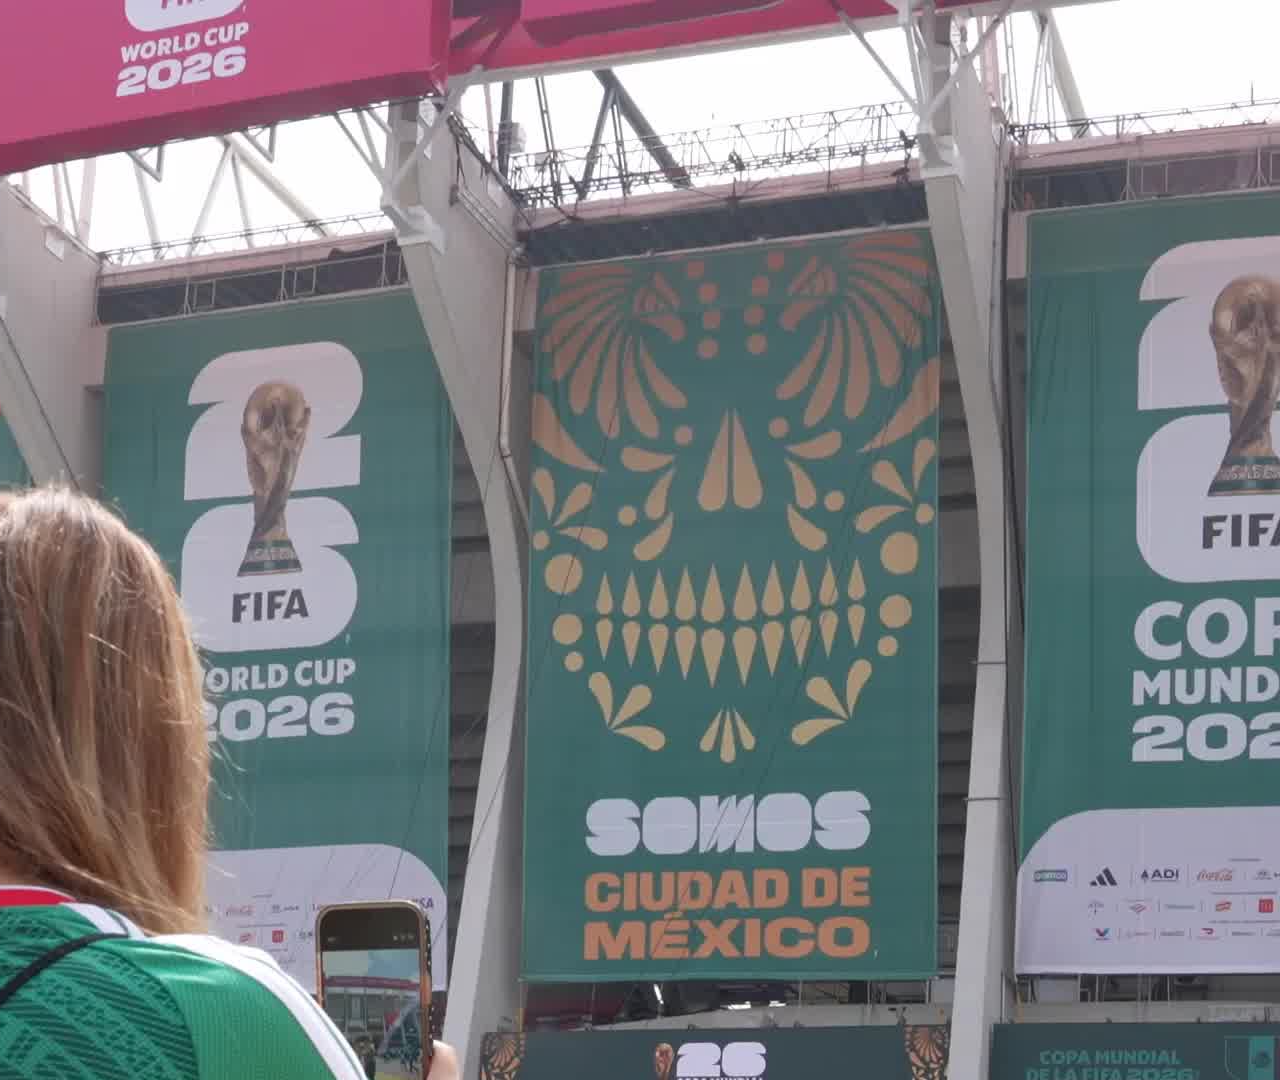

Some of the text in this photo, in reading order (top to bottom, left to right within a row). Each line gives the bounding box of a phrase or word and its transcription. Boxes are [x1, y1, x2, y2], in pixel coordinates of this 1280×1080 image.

[121, 22, 249, 63] WORLD CUP
[116, 46, 246, 97] 2026
[231, 589, 309, 623] FIFA
[202, 658, 356, 693] ORLD CUP
[585, 791, 871, 856] SOMOS
[584, 867, 871, 912] CIUDAD DE
[583, 911, 871, 960] MÉXICO
[1039, 1049, 1182, 1065] COPA MUNDIAL
